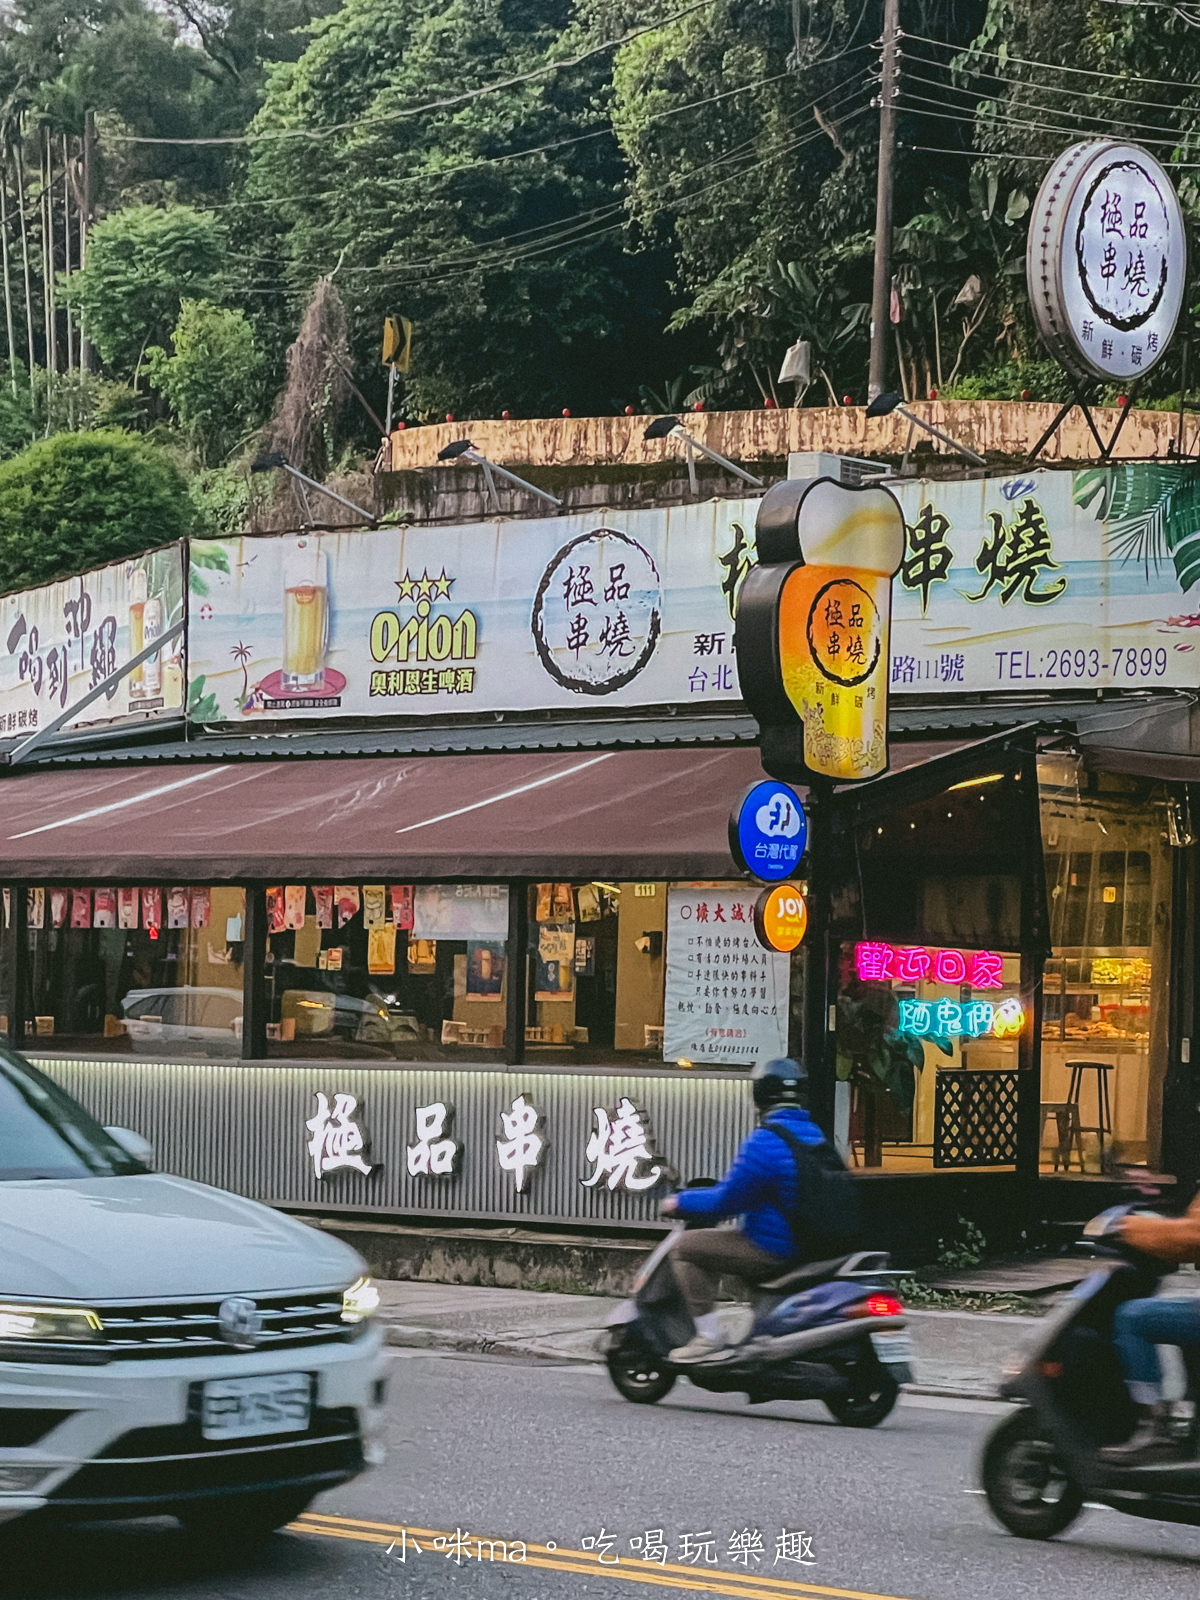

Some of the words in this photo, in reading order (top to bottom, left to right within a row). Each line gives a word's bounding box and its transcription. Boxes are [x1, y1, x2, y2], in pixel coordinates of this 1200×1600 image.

[1101, 190, 1148, 239] 極品
[1101, 242, 1149, 298] 串燒
[900, 497, 1067, 617] 串燒
[562, 563, 631, 611] 極品
[369, 599, 478, 664] Orion
[566, 611, 635, 660] 串燒
[824, 598, 864, 629] 極品
[688, 664, 733, 693] 台北
[891, 653, 964, 683] 路111號
[995, 647, 1168, 680] TEL:2693-7899
[827, 633, 868, 665] 串燒
[777, 897, 804, 919] JOY
[857, 942, 1003, 988] 歡迎回家
[900, 999, 993, 1036] 酒鬼們
[306, 1090, 662, 1194] 極品串燒
